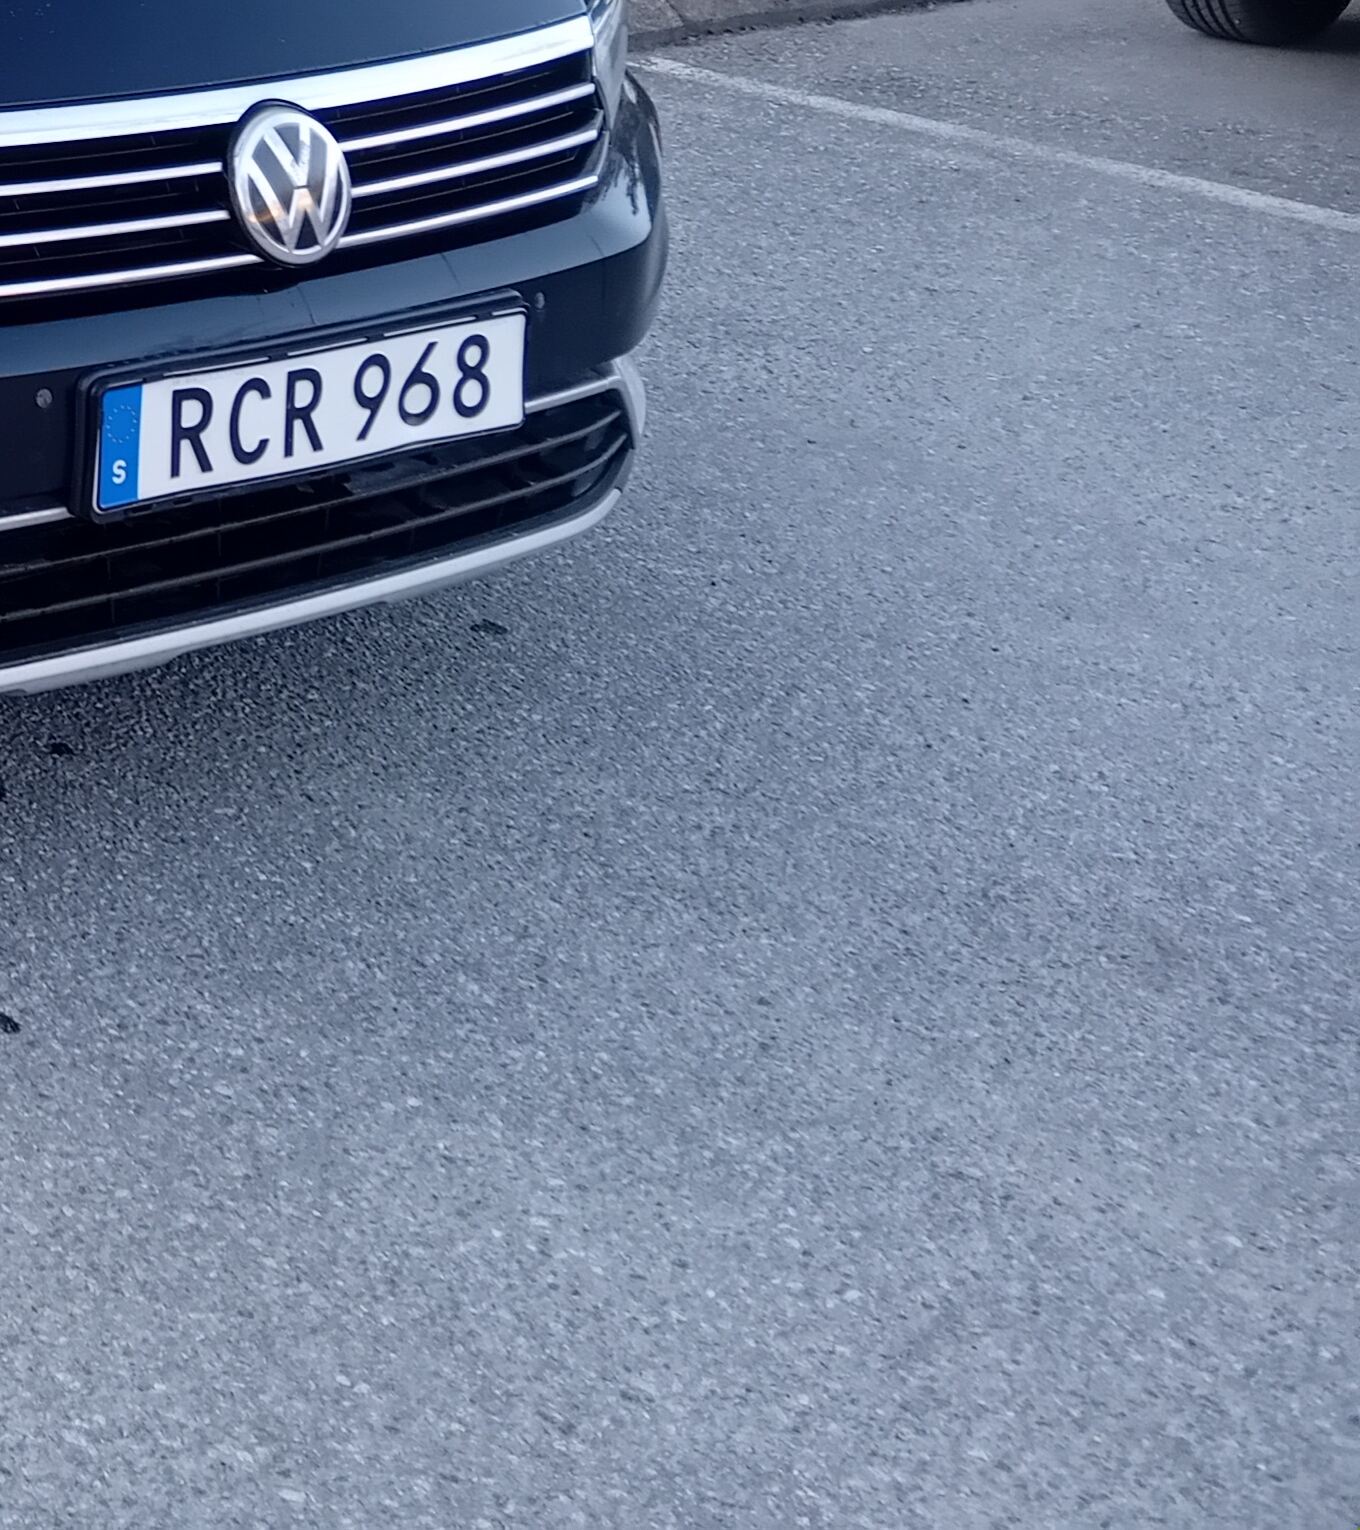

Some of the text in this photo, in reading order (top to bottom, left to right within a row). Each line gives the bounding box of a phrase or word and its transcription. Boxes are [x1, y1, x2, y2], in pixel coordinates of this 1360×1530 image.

[239, 115, 347, 257] VW
[112, 459, 127, 485] S
[170, 333, 489, 478] RCR 968
